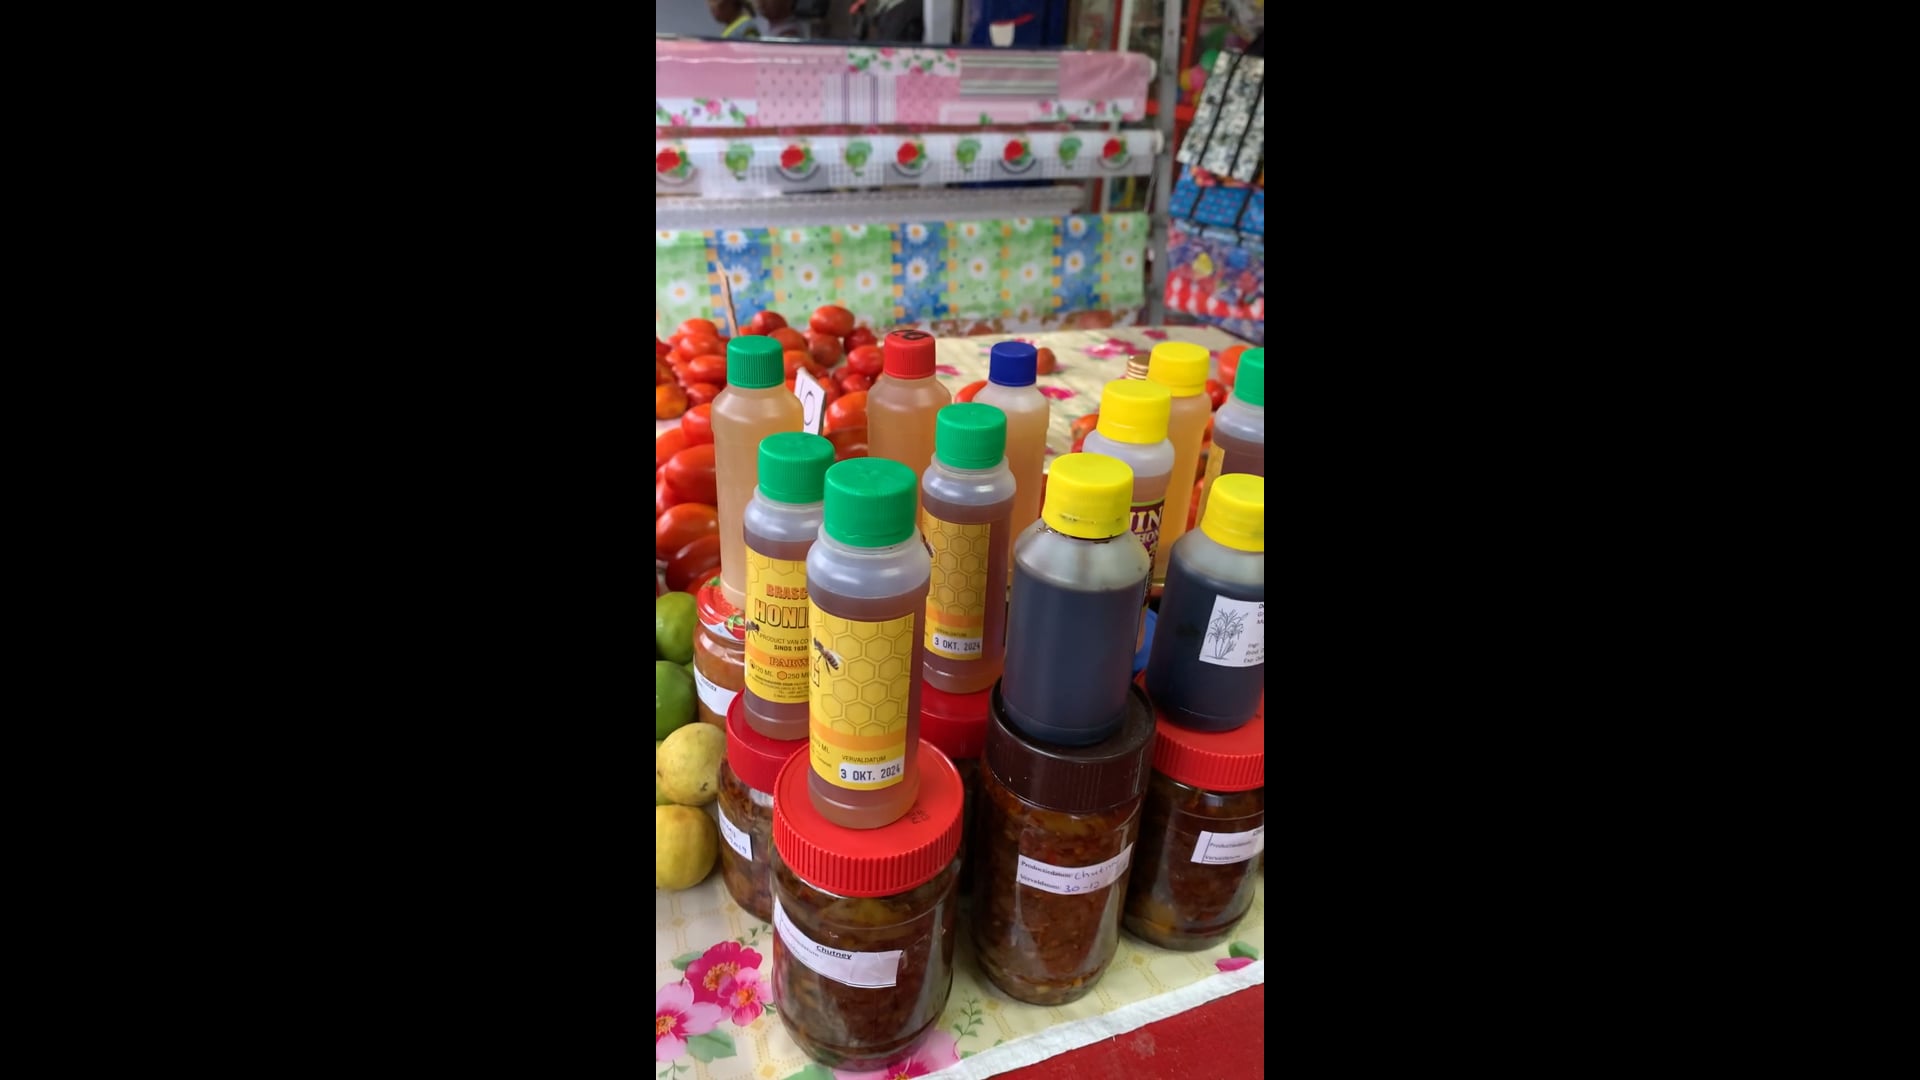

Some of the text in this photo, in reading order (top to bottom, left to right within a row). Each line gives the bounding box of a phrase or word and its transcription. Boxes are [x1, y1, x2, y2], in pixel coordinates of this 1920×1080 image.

[755, 599, 809, 628] HONI
[759, 634, 785, 644] PRODUCT
[934, 637, 980, 651] 3 OKT. 2024
[842, 754, 887, 764] VERVALDATUM
[840, 763, 901, 782] 3 OKT. 2024
[816, 945, 852, 961] Chutney
